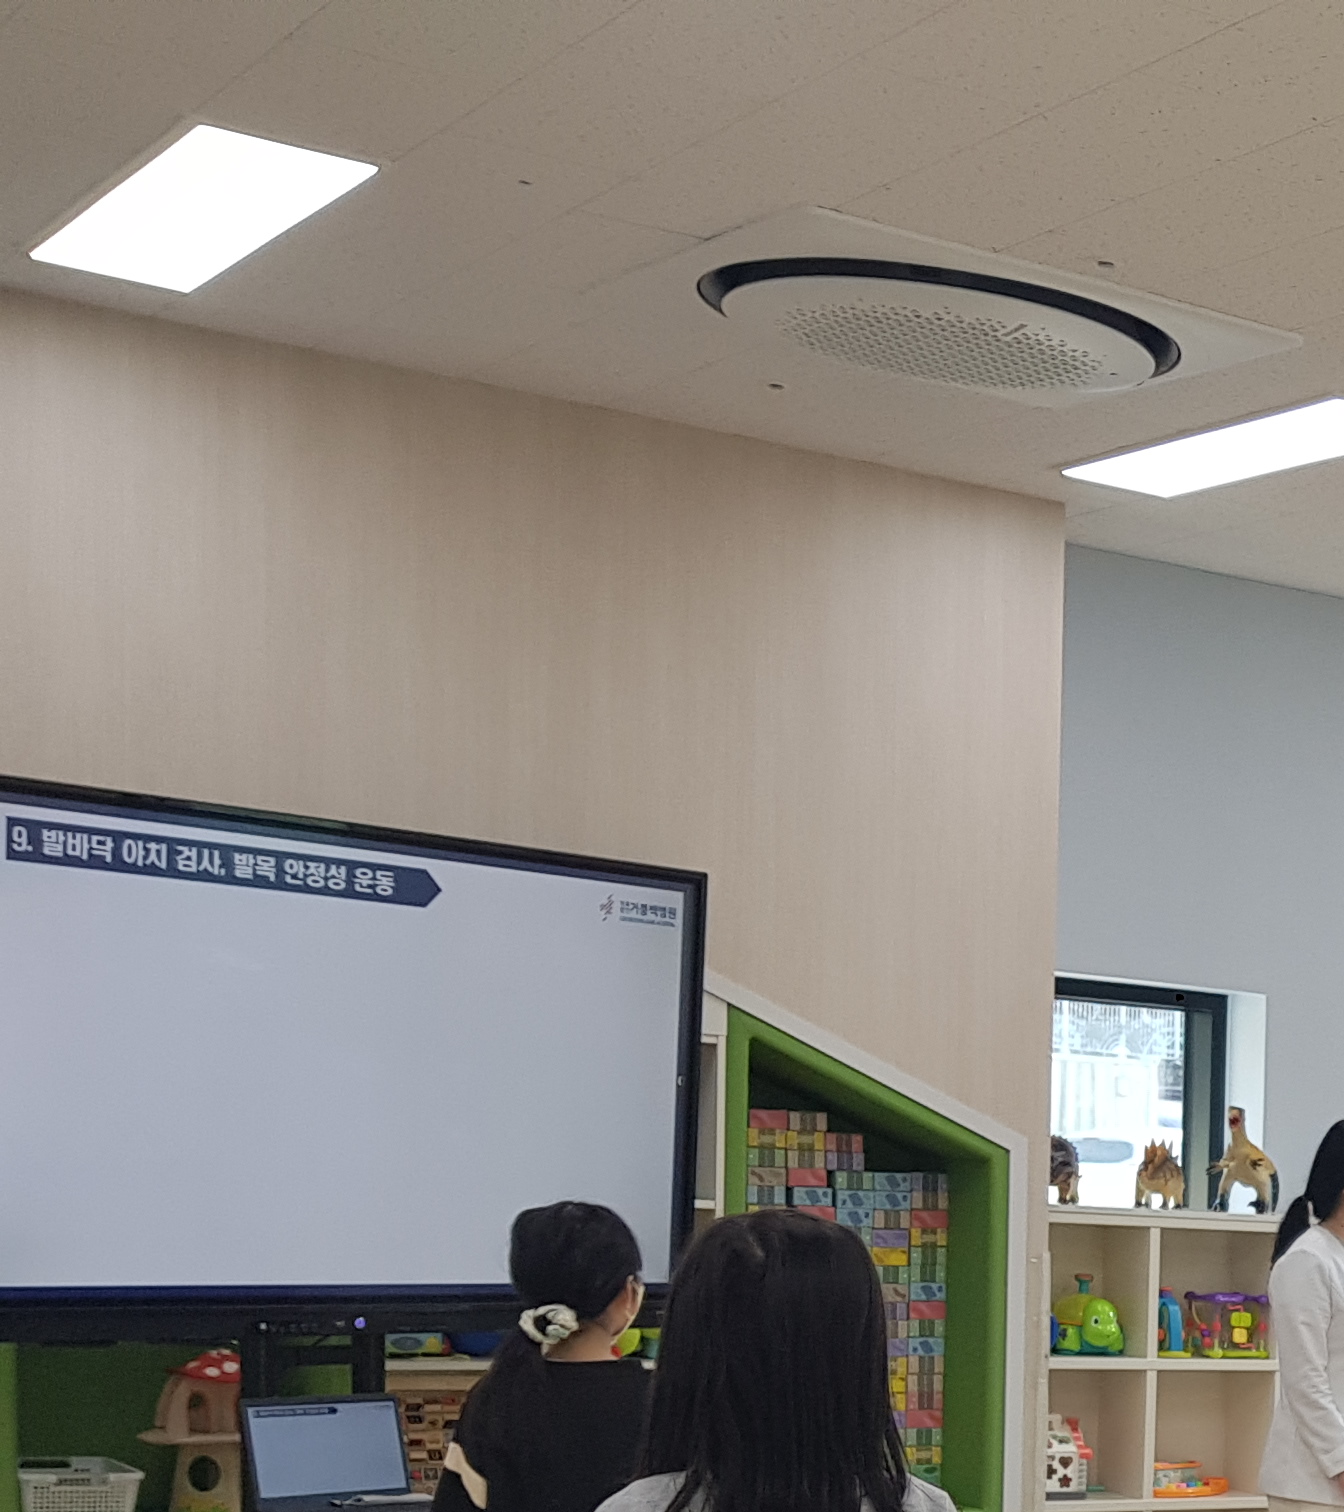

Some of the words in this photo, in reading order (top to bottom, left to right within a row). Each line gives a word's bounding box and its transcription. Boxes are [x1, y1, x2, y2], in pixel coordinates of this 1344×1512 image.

[11, 825, 33, 852] 9.
[41, 828, 114, 863] 발바닥
[122, 838, 168, 870] 아치
[175, 845, 226, 876] 검사,
[233, 852, 277, 882] 발목
[283, 858, 347, 890] 안정성
[352, 867, 395, 896] 운동
